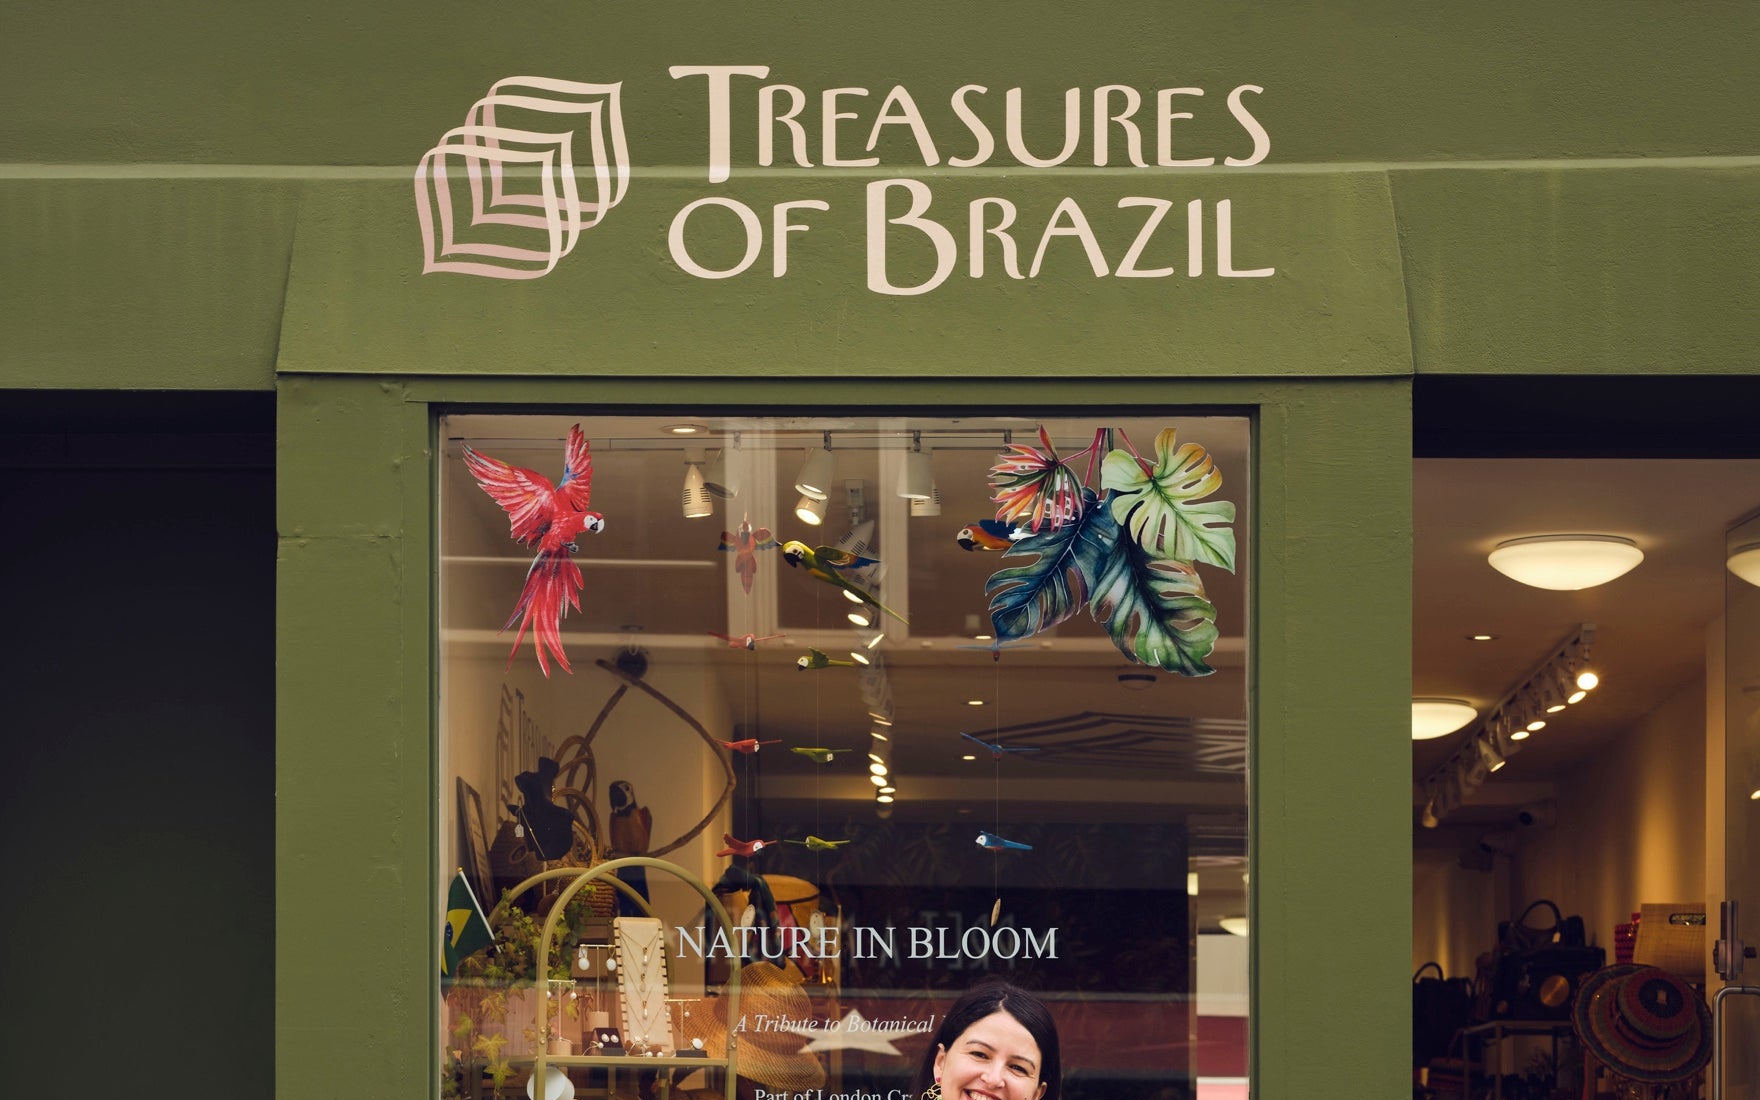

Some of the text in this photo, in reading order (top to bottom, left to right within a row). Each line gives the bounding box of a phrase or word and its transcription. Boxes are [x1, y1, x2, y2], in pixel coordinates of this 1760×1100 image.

[669, 65, 1271, 184] TREASURES
[668, 178, 1275, 295] OF BRAZIL
[675, 926, 841, 959] NATURE
[853, 927, 896, 959] IN
[907, 926, 1059, 959] BLOOM
[734, 1015, 746, 1032] A
[754, 1014, 818, 1033] Tribute
[824, 1017, 841, 1032] to
[847, 1014, 934, 1033] Botanical
